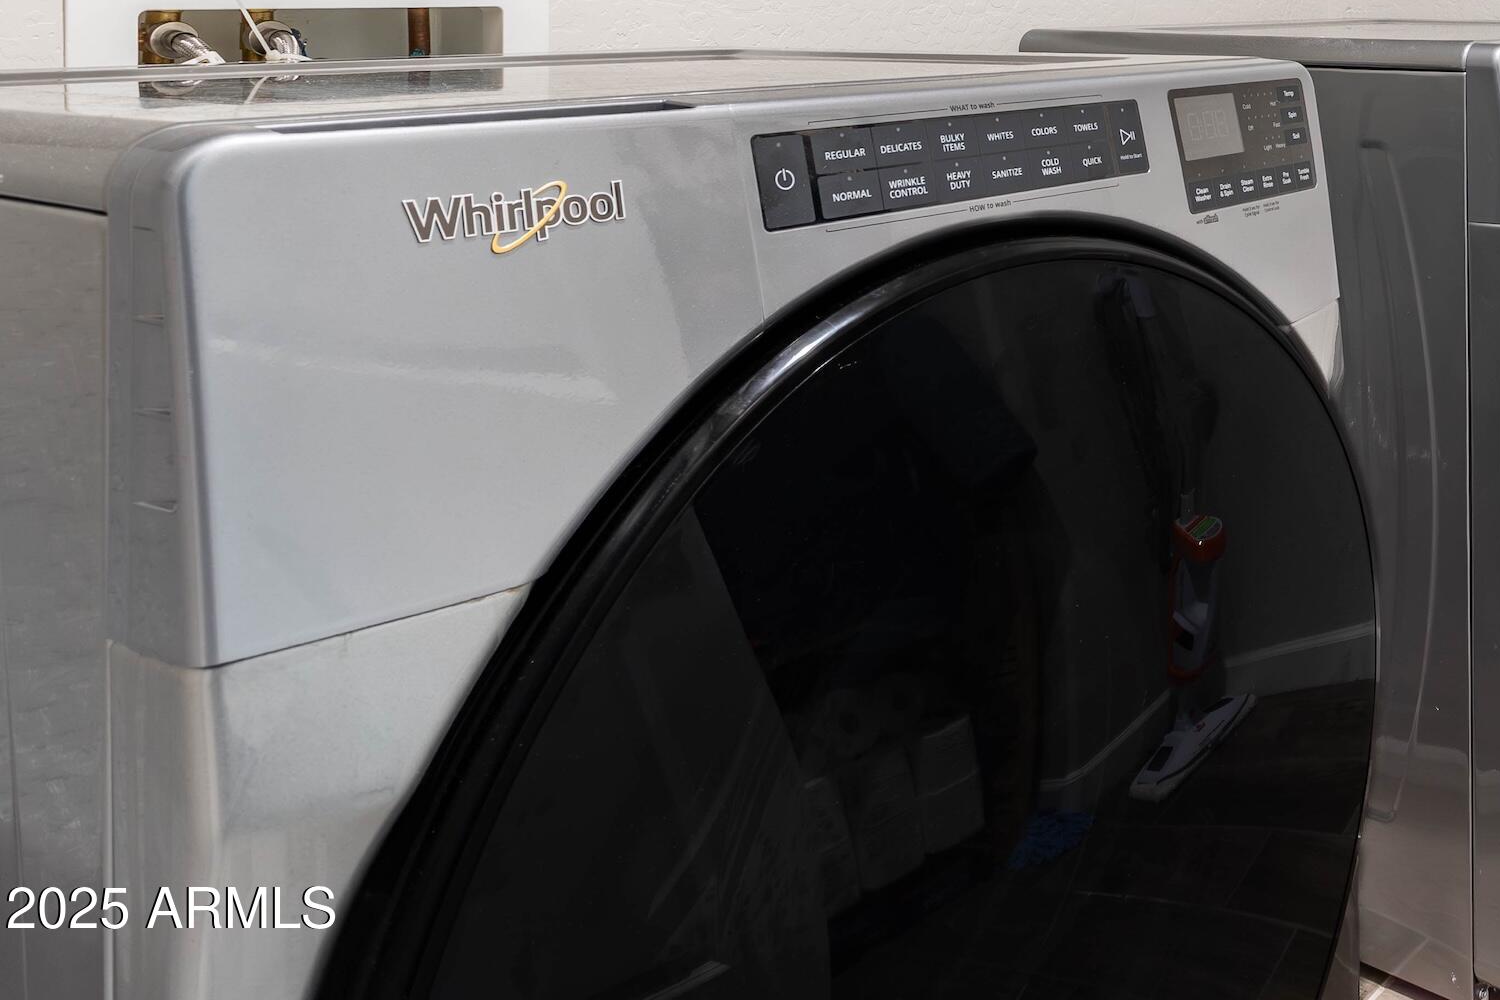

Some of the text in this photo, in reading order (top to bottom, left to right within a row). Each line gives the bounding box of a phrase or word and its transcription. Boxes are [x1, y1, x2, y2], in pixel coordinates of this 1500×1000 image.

[1283, 90, 1294, 98] Temp
[949, 103, 969, 112] WHAT
[978, 102, 995, 110] wash
[1287, 111, 1297, 119] Spin
[1031, 126, 1058, 137] COLORS
[1073, 122, 1098, 132] TOWELS
[940, 133, 965, 144] BULKY
[987, 131, 1014, 142] WHITES
[880, 141, 922, 154] DELICATES
[943, 142, 966, 152] ITEMS
[824, 148, 866, 161] REGULAR
[1041, 158, 1059, 167] COLD
[1082, 156, 1102, 167] QUICK
[946, 170, 971, 181] HEAVY
[992, 168, 1023, 179] SANITIZE
[1041, 166, 1062, 176] WASH
[888, 176, 926, 189] WRINKLE
[950, 180, 971, 190] DUTY
[889, 186, 928, 199] CONTROL
[1195, 187, 1209, 195] Clean
[1242, 185, 1254, 193] Clean
[832, 189, 872, 203] NORMAL
[1195, 194, 1212, 202] Washer
[969, 204, 985, 213] HOW
[994, 200, 1012, 208] wash
[402, 180, 626, 245] Whirlpool
